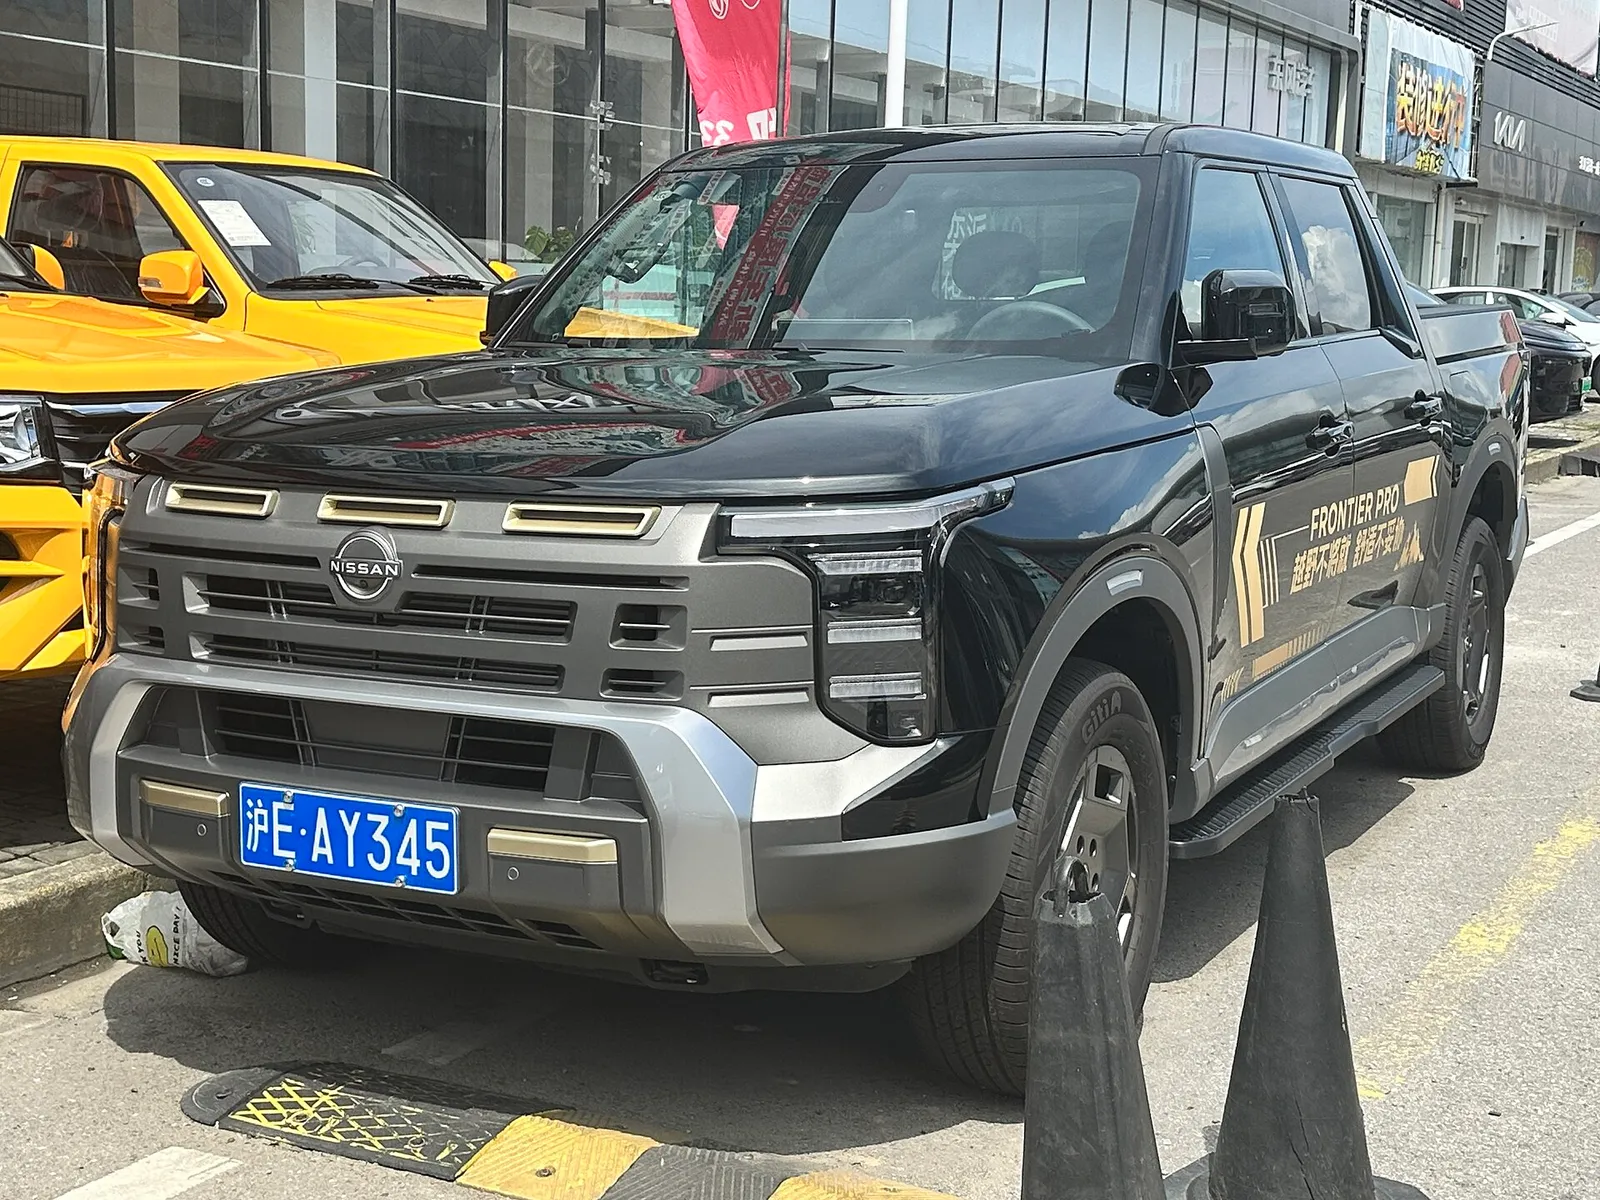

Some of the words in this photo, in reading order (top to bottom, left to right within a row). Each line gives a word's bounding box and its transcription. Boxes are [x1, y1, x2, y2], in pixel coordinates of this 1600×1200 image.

[1310, 491, 1374, 541] FRONTIER
[1375, 484, 1400, 519] PRO
[330, 560, 398, 576] NISSAN
[1290, 533, 1352, 594] 越野不将就
[172, 935, 181, 965] NICE
